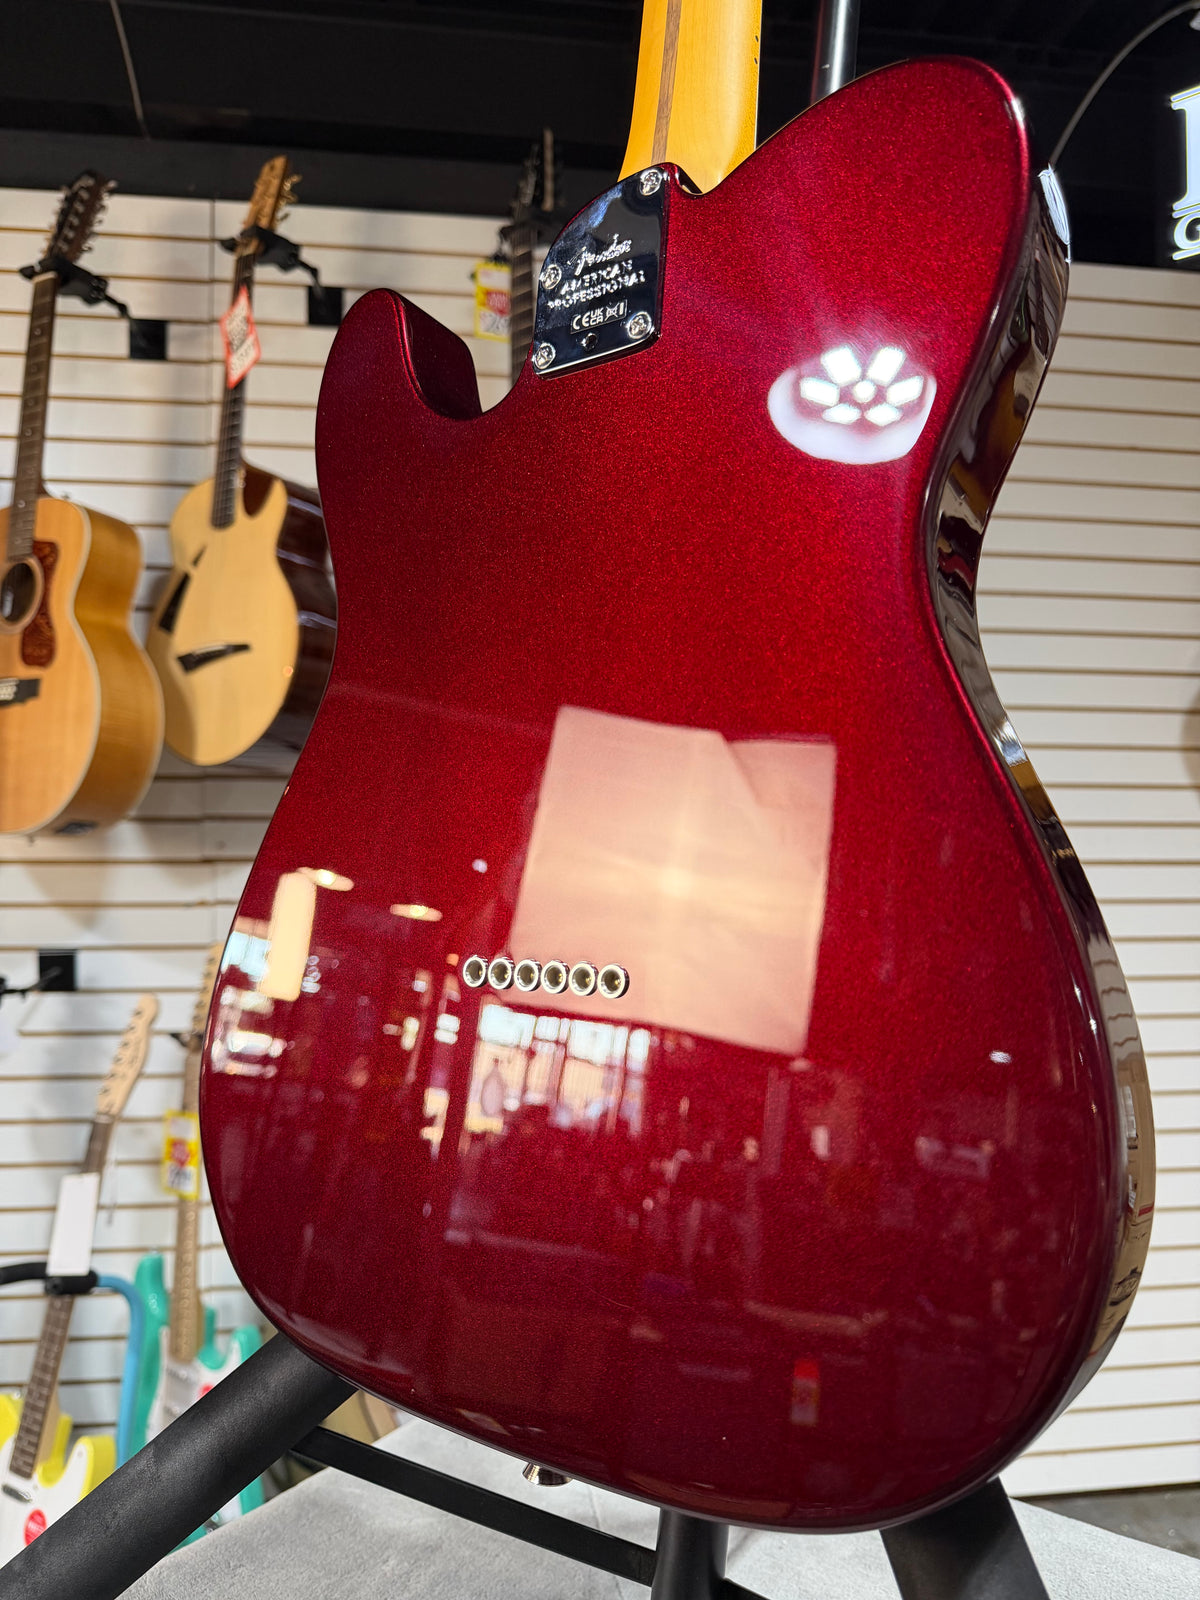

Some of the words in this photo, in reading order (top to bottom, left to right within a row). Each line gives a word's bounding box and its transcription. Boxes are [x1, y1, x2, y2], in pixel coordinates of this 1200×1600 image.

[560, 260, 633, 295] AMERICAN
[590, 307, 604, 318] UK
[590, 316, 604, 327] CA
